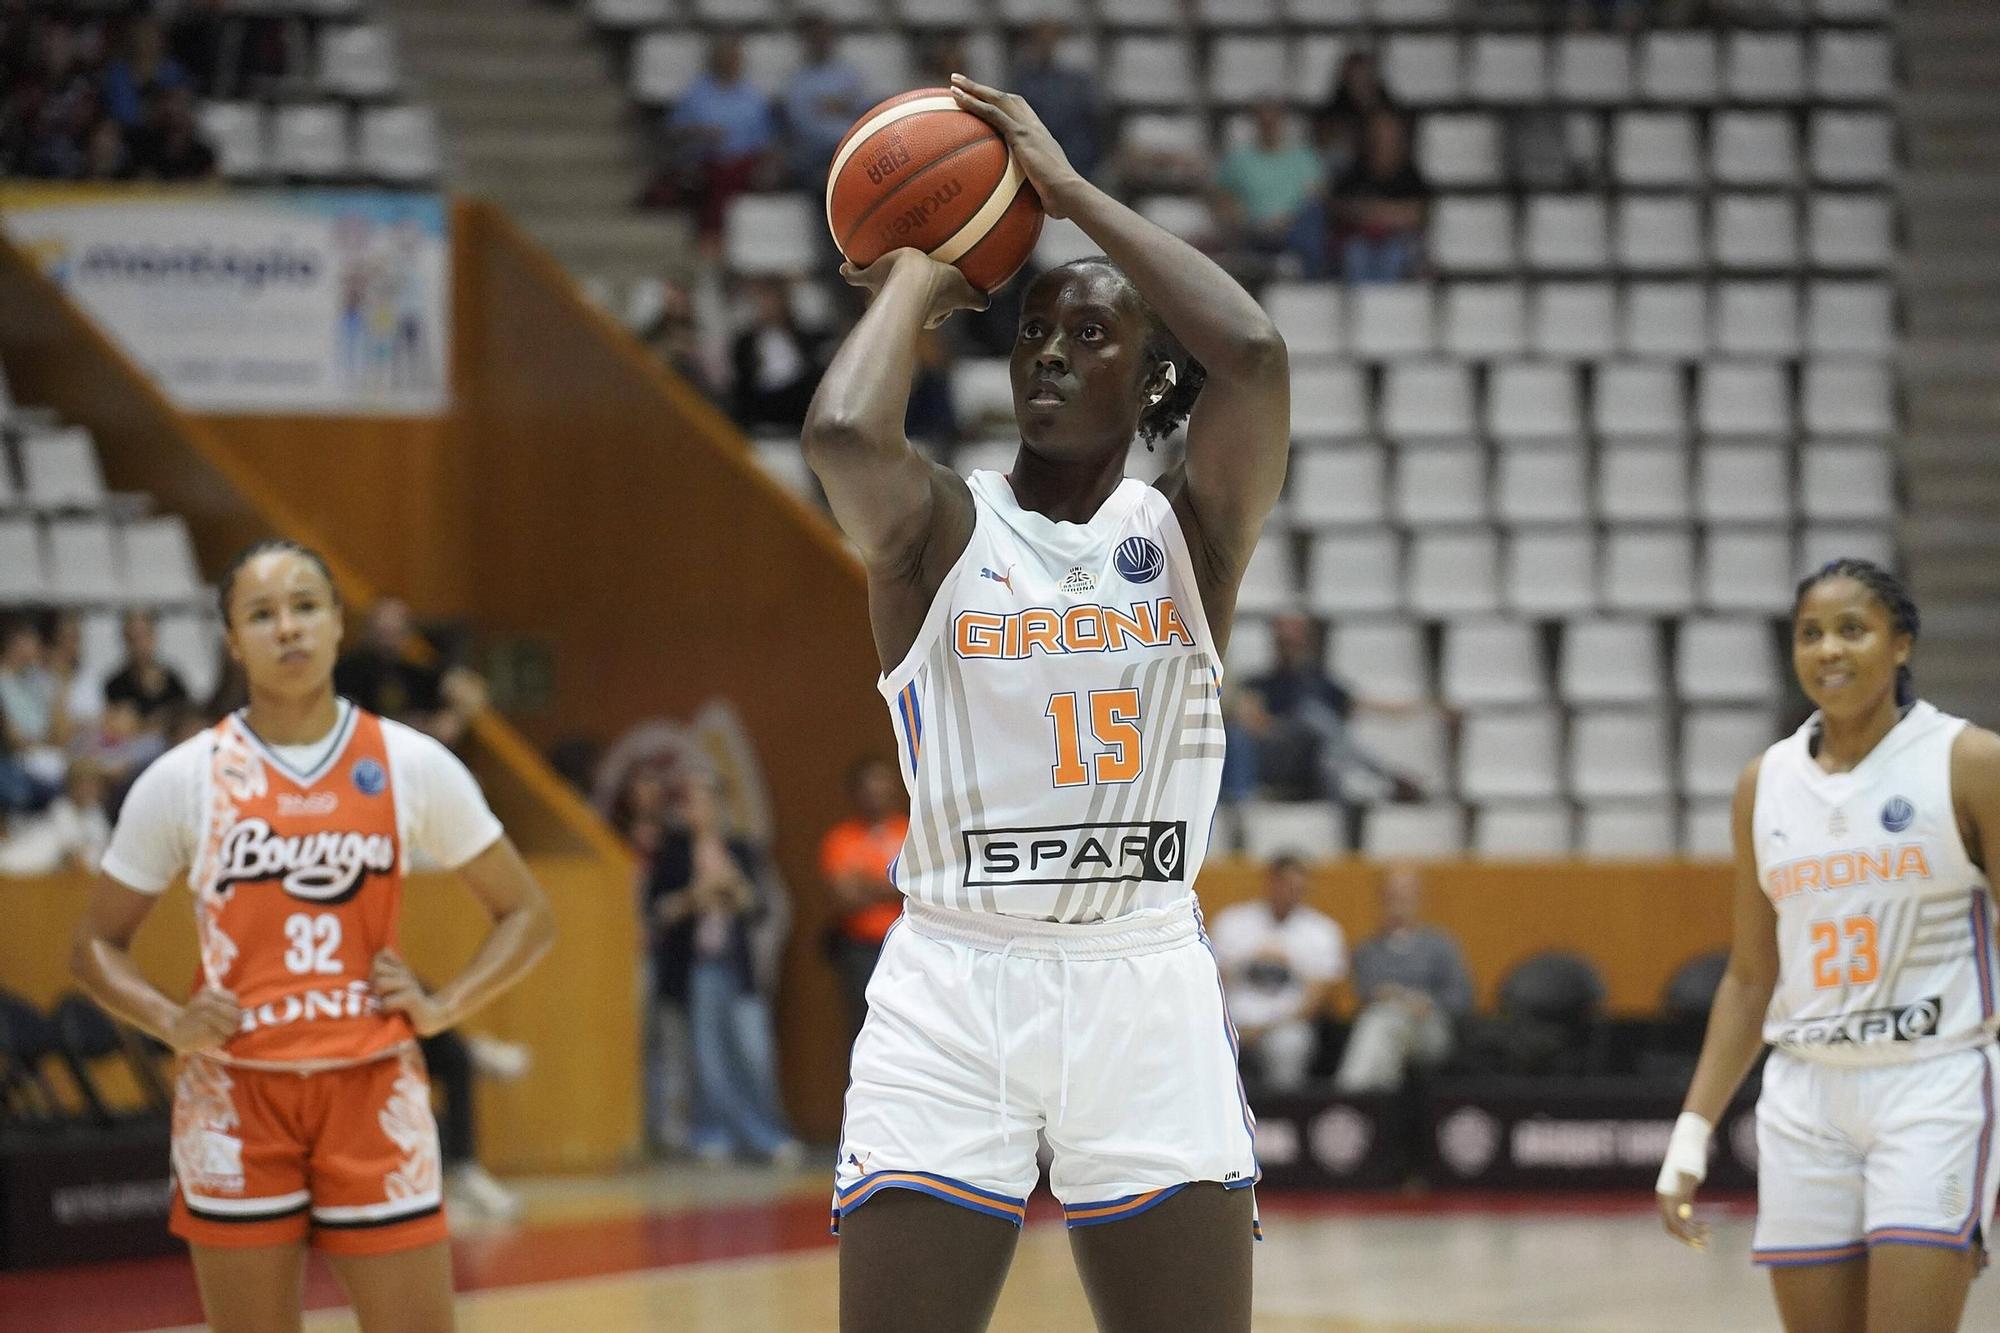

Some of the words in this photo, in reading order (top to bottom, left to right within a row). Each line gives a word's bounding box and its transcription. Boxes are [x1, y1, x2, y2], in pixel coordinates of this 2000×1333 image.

[867, 145, 911, 186] FIBA
[880, 178, 963, 241] molten
[953, 596, 1196, 661] GIRONA
[1044, 687, 1144, 789] 15
[983, 835, 1149, 874] SPAR
[283, 912, 344, 976] 32
[1809, 913, 1881, 992] 23
[1224, 1170, 1240, 1181] UNI
